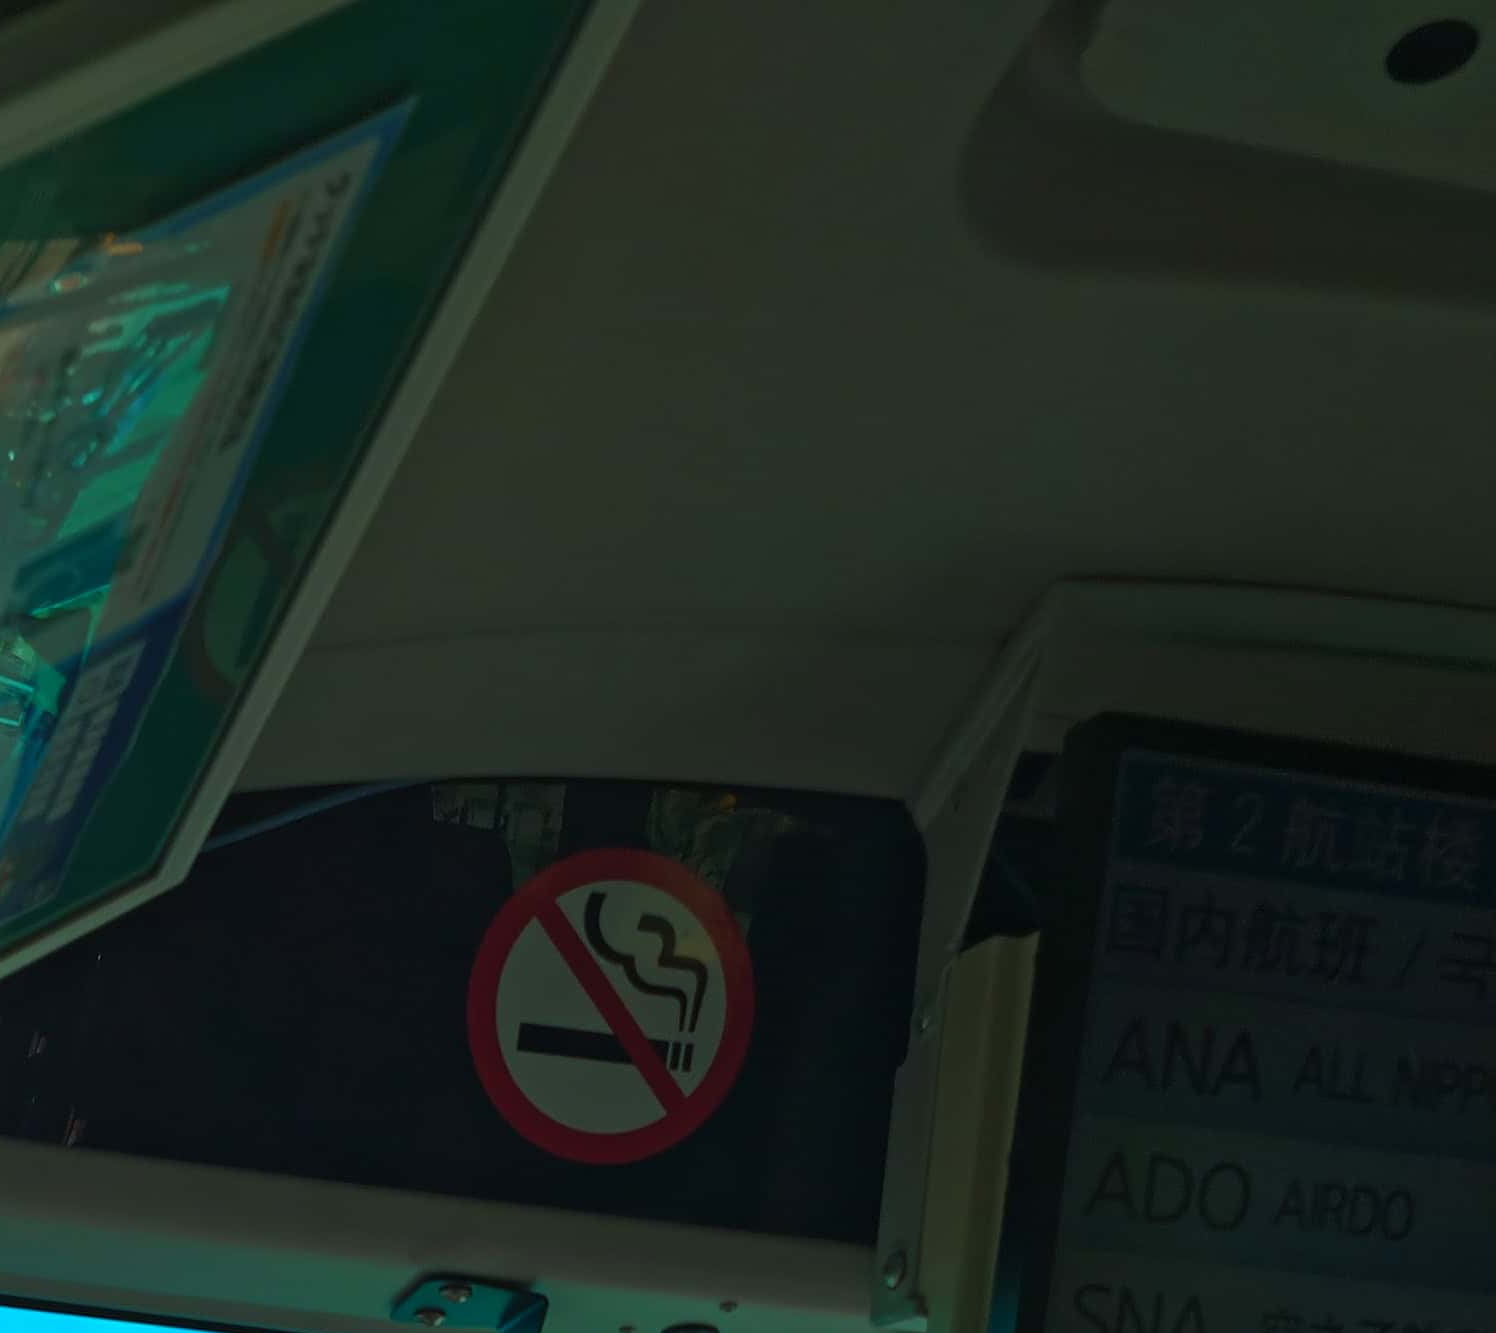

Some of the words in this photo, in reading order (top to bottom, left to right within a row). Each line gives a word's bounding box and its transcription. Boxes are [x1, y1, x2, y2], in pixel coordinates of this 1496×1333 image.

[1106, 883, 1378, 985] 国内航班
[1103, 1014, 1262, 1101] ANA
[1292, 1045, 1376, 1104] ALL
[1390, 1054, 1496, 1113] NIPP
[1084, 1150, 1252, 1232] ADO
[1272, 1178, 1416, 1241] AIRDO
